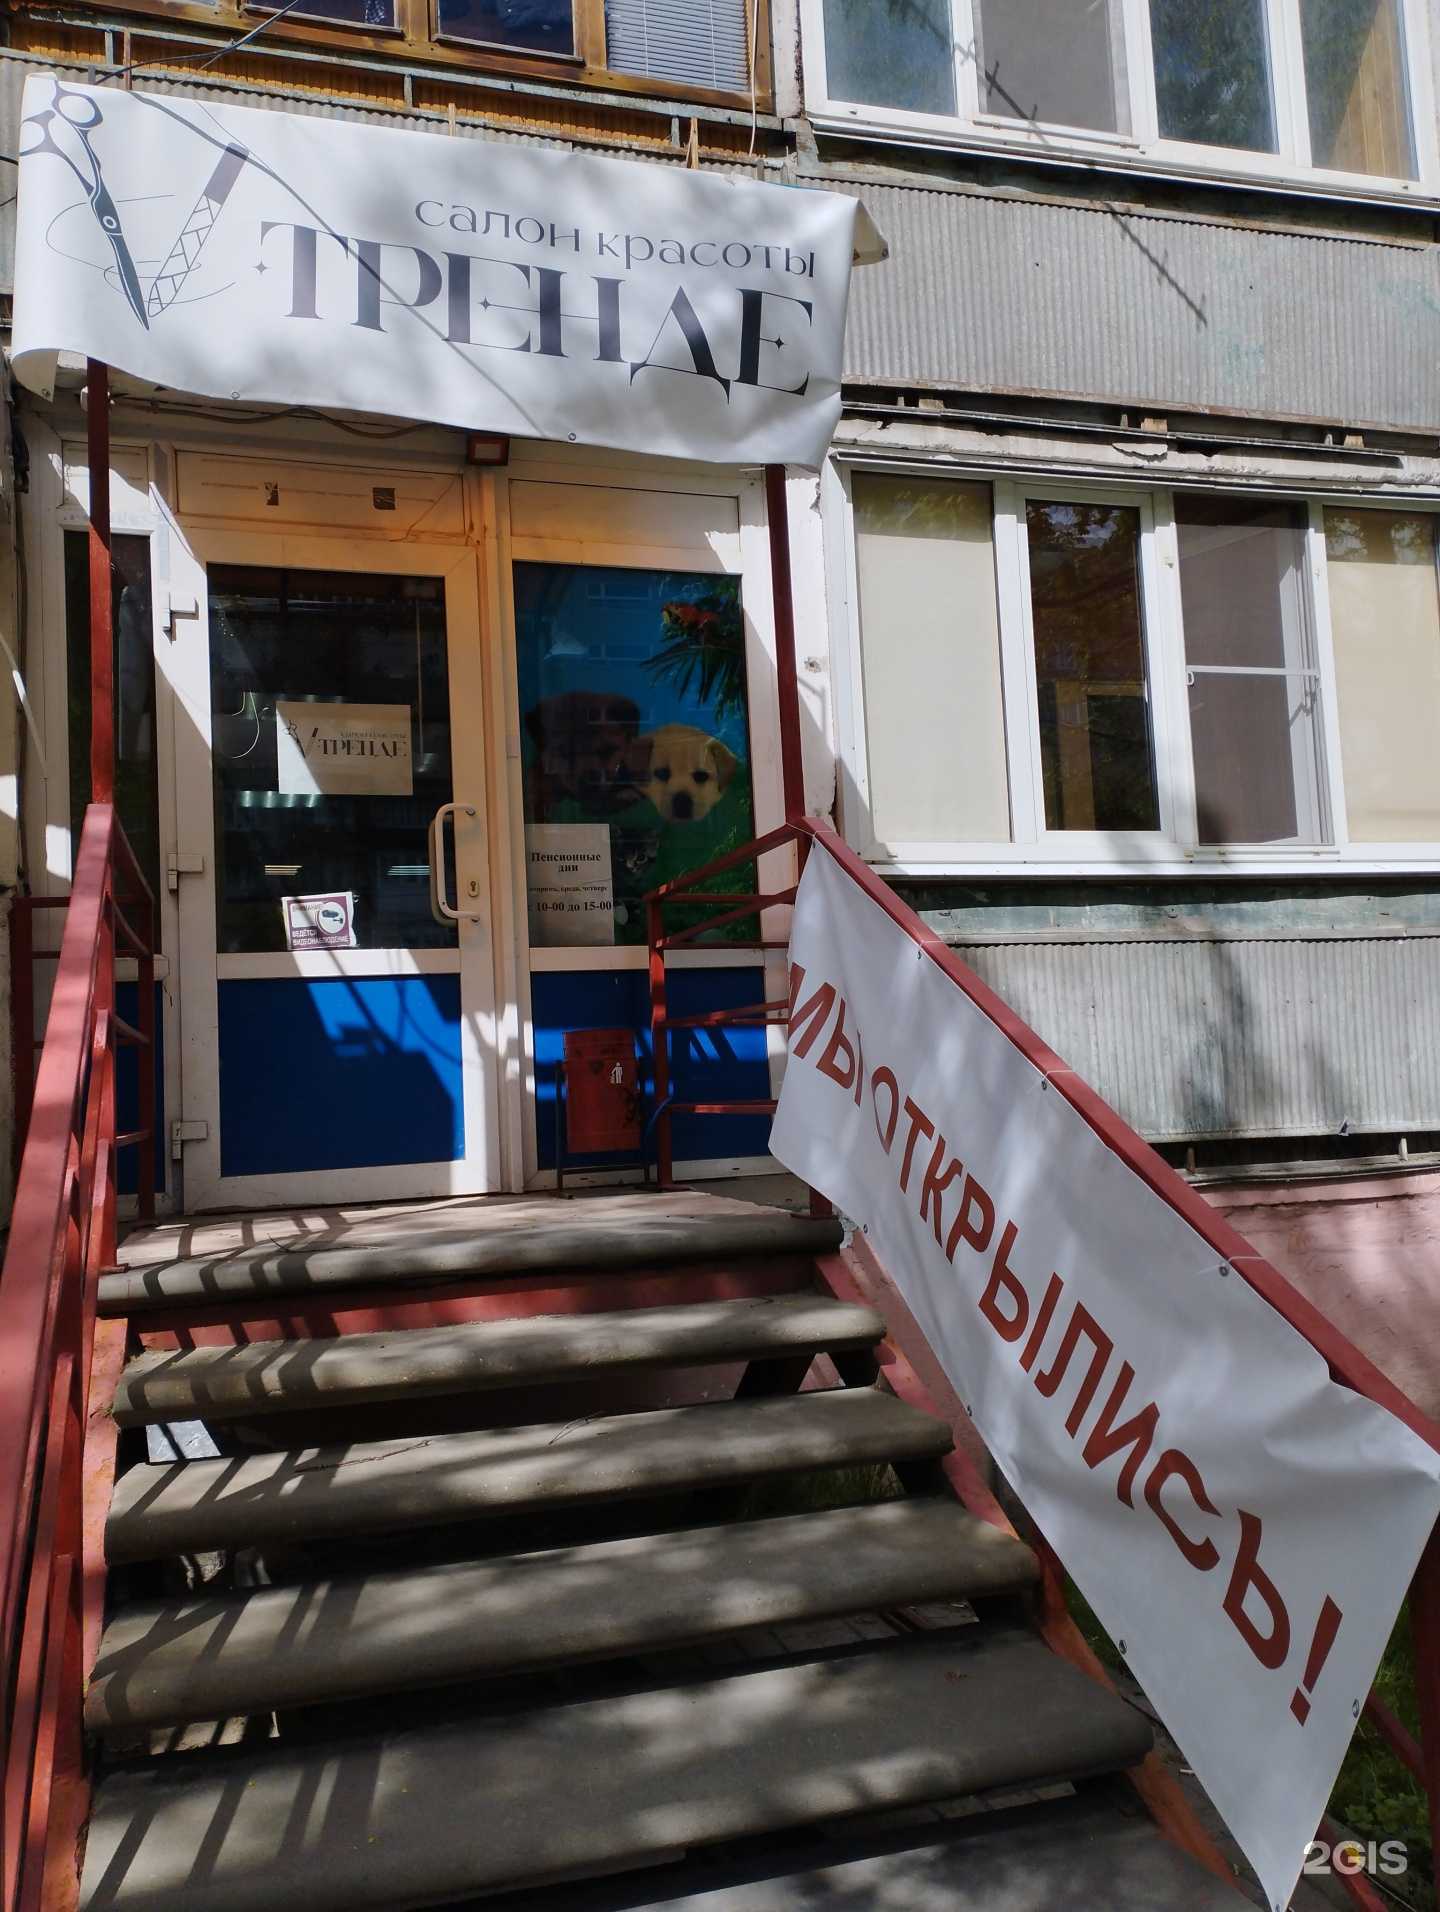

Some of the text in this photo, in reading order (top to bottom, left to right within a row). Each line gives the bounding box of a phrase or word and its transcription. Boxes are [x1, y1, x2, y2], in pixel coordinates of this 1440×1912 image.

[414, 199, 816, 278] салон красоты
[260, 219, 814, 405] ТРЕНДЕ
[531, 852, 601, 862] Пенсионные
[558, 863, 580, 873] дни
[536, 901, 565, 912] 10-00
[567, 903, 581, 913] до
[583, 900, 612, 911] 15-00
[788, 961, 1344, 1728] МЫ ОТКРЫЛИСЬ!
